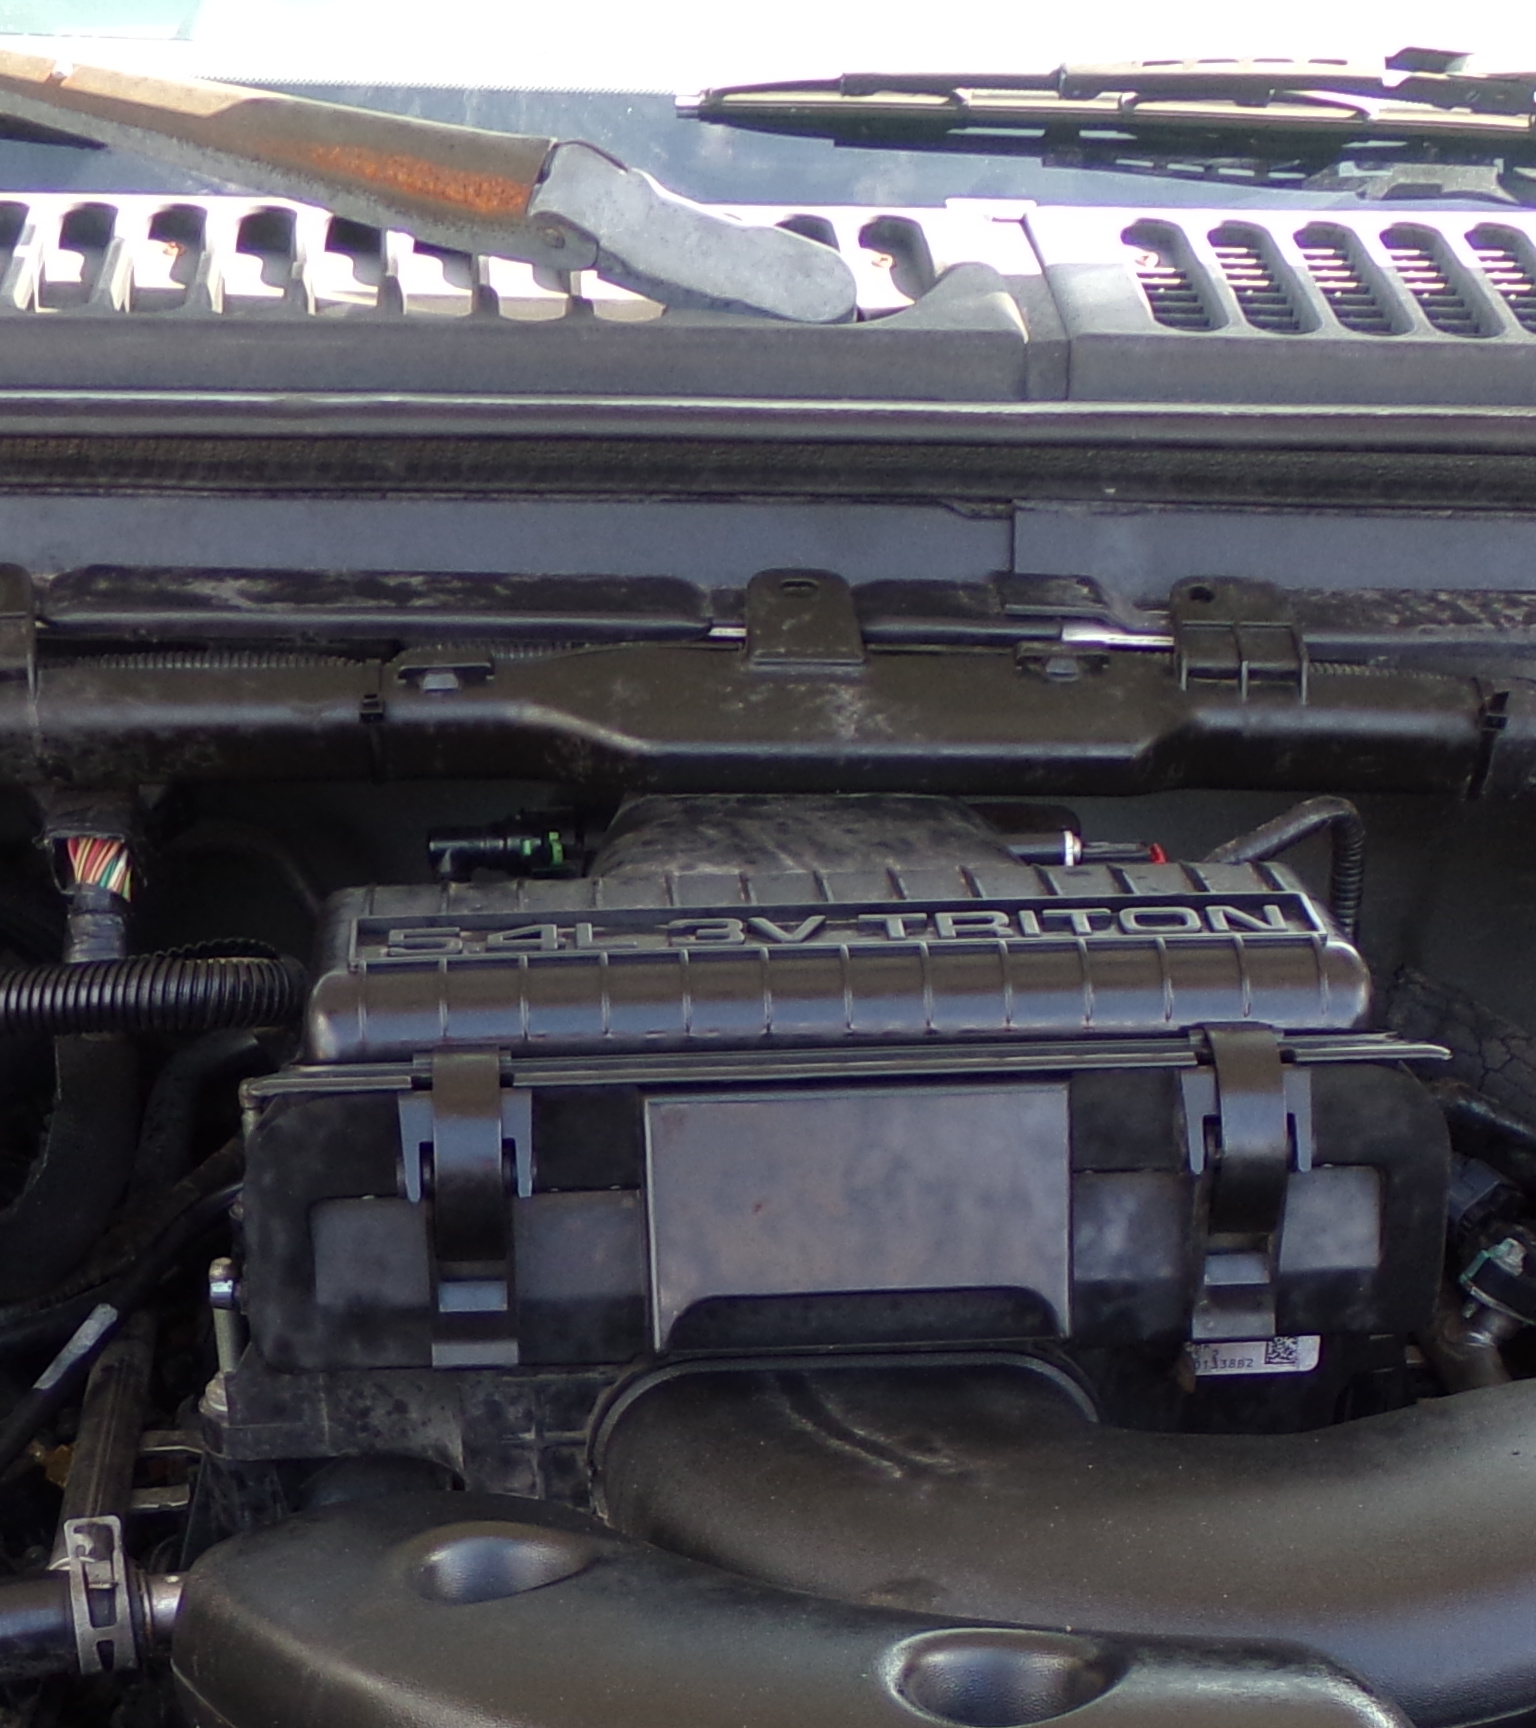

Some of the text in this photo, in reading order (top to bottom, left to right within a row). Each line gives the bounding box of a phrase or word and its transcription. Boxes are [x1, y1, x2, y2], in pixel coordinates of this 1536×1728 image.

[388, 904, 1288, 957] 5.4L 3V TRITON
